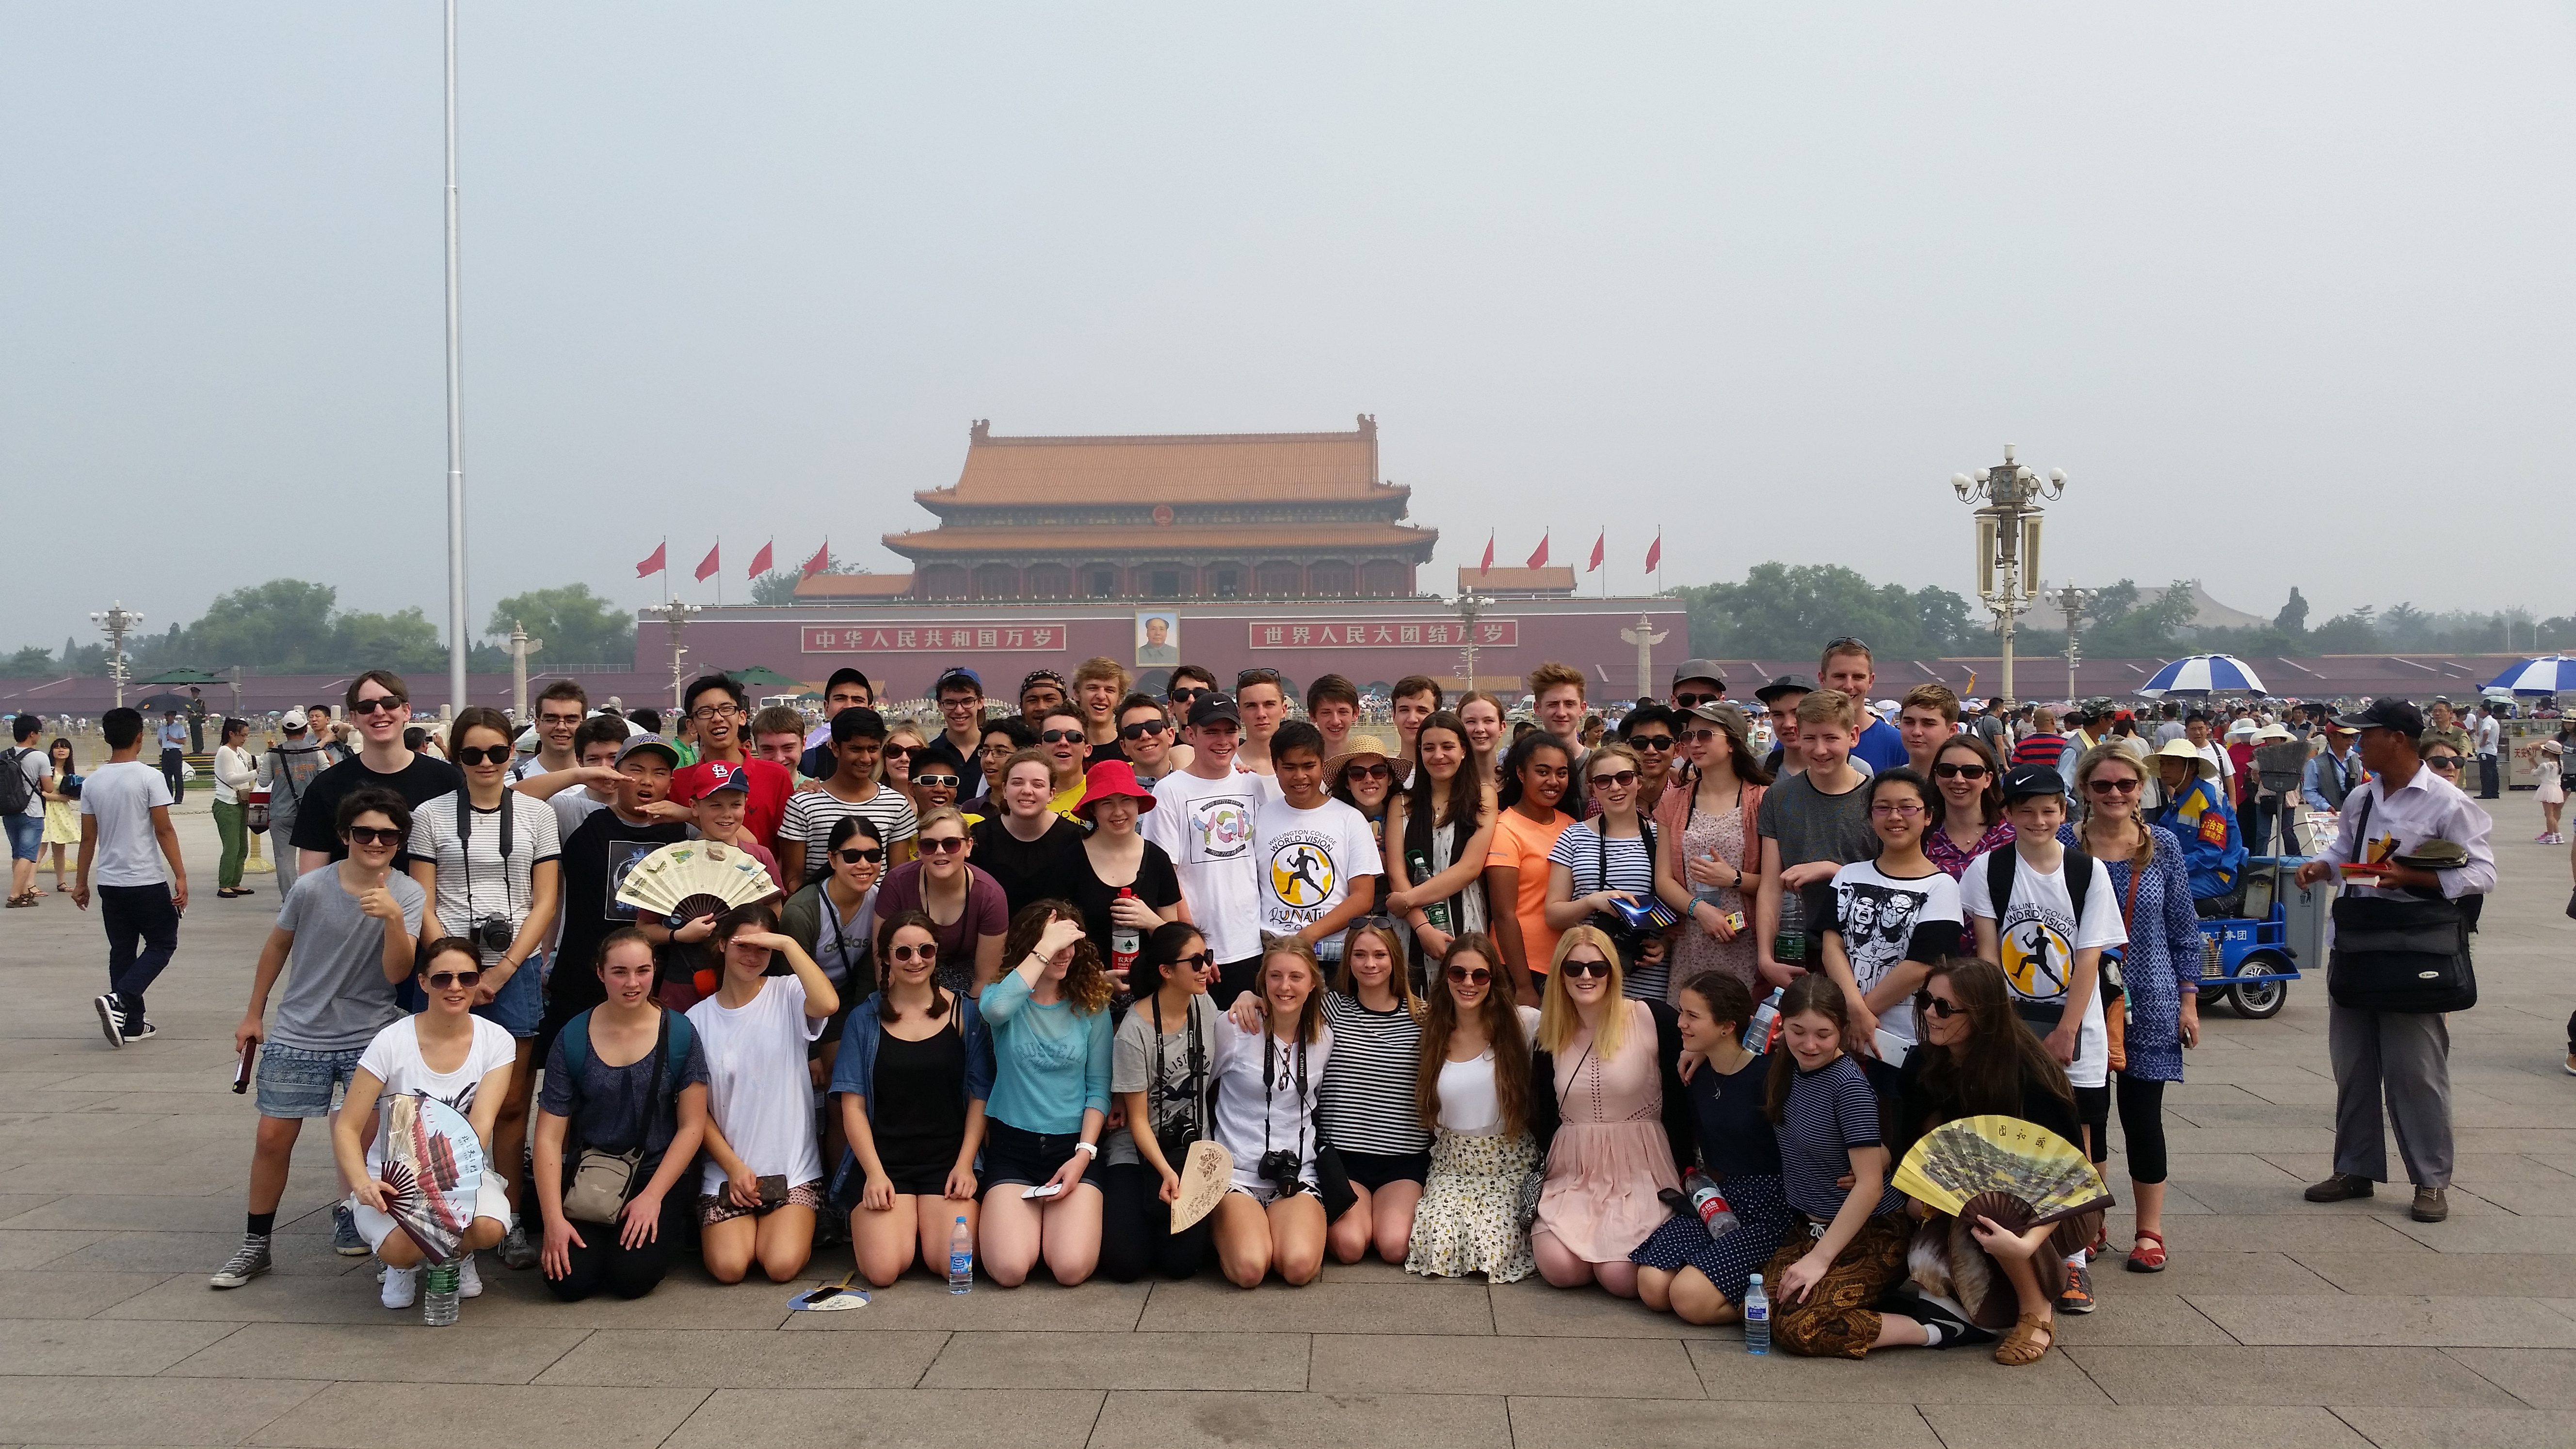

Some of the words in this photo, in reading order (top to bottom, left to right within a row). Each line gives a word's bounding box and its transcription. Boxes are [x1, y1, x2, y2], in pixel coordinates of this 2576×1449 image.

[816, 629, 1052, 648] 中华人民共和国万岁
[1268, 830, 1308, 846] WELLINGTON
[1310, 830, 1337, 846] COLLEGE
[1270, 835, 1302, 853] WORLD
[1305, 835, 1333, 853] VISION
[2045, 908, 2077, 929] COLLEGE
[824, 934, 869, 953] addas
